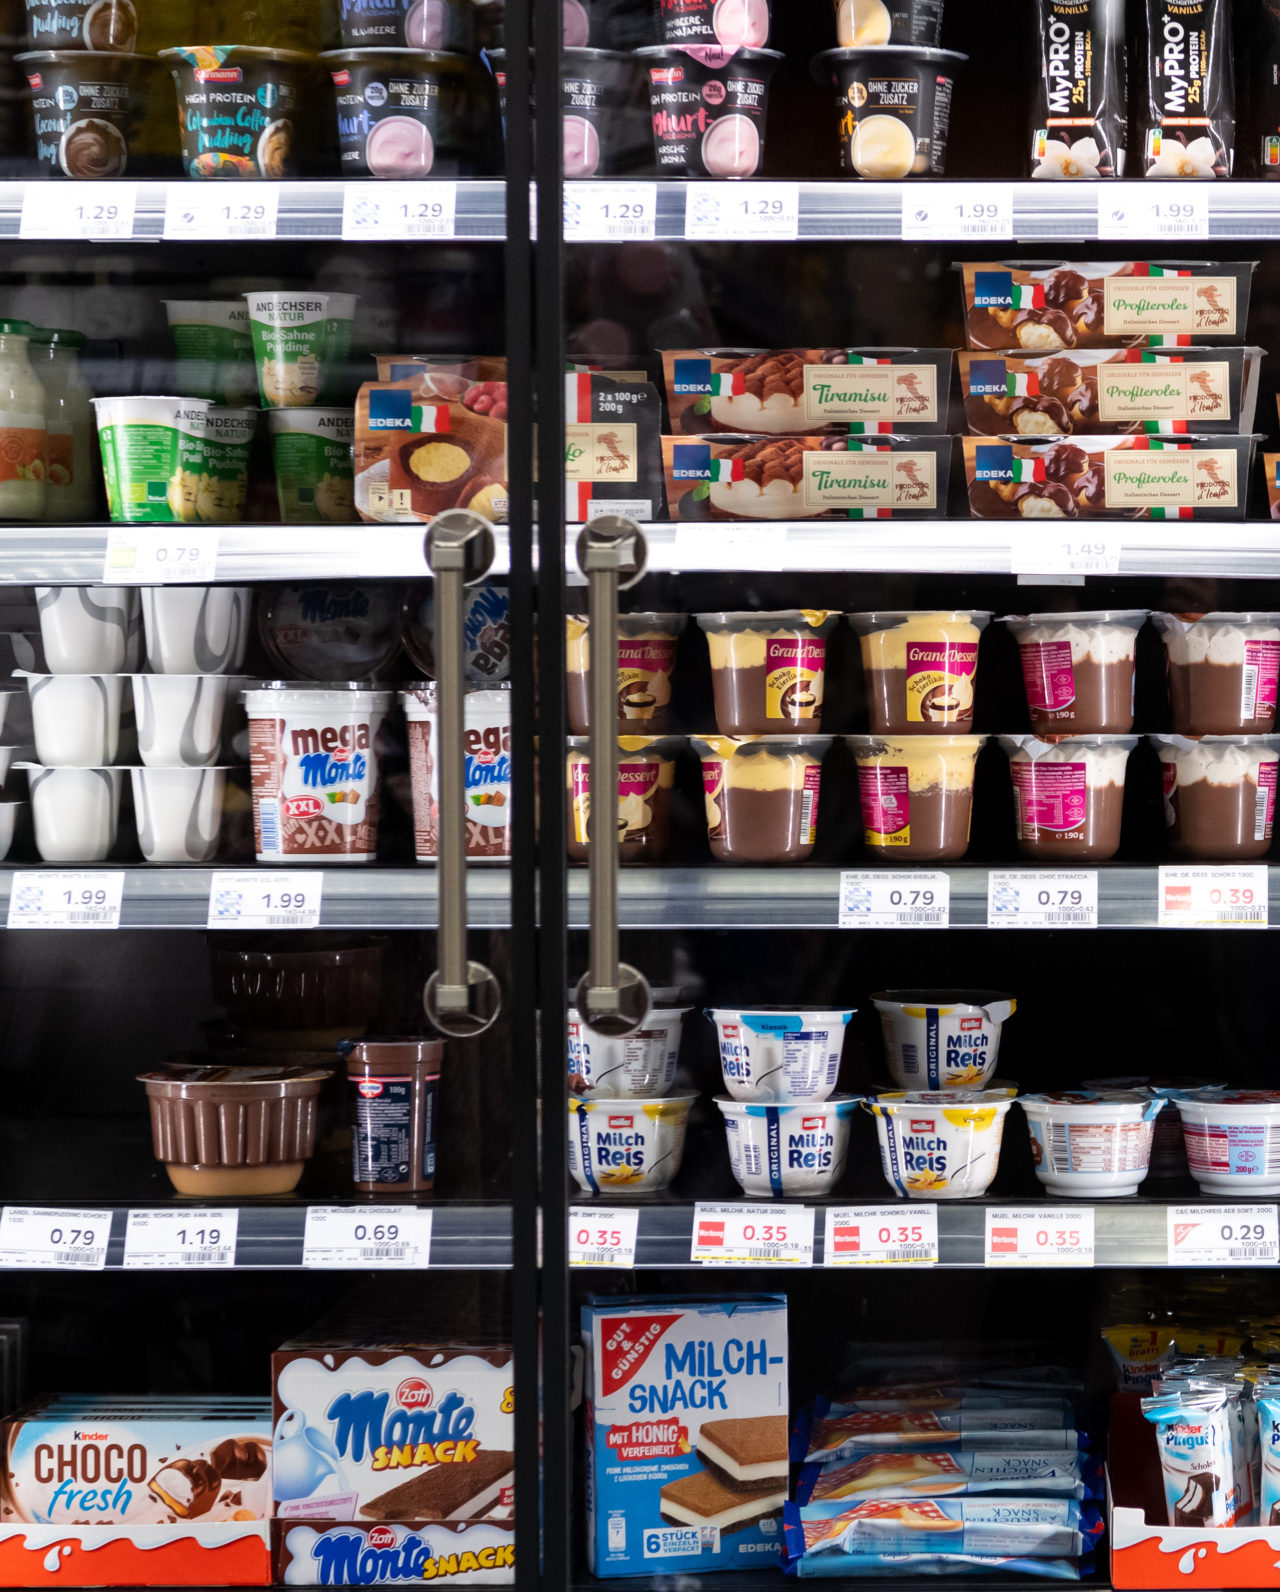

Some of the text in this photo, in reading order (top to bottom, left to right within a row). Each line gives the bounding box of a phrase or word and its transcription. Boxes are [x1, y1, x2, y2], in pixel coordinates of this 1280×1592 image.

[1053, 5, 1088, 15] VANILLE
[1072, 31, 1086, 104] 25g PROTEIN
[1188, 31, 1201, 104] 25g PROTEIN
[868, 82, 918, 93] OHNE ZUCKER
[186, 93, 256, 104] HIGH PROTEIN
[880, 94, 907, 104] ZUSATZ
[600, 203, 645, 218] 1.29
[739, 199, 784, 215] 1.29
[1150, 204, 1194, 218] 1.99
[256, 302, 322, 312] ANDECHSER
[975, 297, 1013, 305] EDEKA
[269, 313, 304, 321] NATUR
[267, 342, 310, 354] Pudding
[812, 384, 890, 404] Tiramisu
[970, 385, 1008, 393] EDEKA
[1106, 384, 1182, 403] Profiteroles
[369, 418, 412, 427] EDEKA
[812, 470, 889, 491] Tiramisu
[976, 470, 1014, 478] EDEKA
[1113, 471, 1189, 489] Profiteroles
[156, 548, 200, 562] 0.79
[291, 724, 370, 755] mega
[289, 801, 319, 815] XXL
[63, 890, 107, 906] 1.99
[261, 893, 306, 910] 1.99
[890, 891, 934, 905] 0.79
[1037, 891, 1082, 905] 0.79
[1210, 889, 1254, 904] 0.39
[947, 1034, 988, 1048] Milch
[929, 1023, 937, 1077] ORIGINAL
[946, 1049, 986, 1068] Reis
[597, 1132, 645, 1146] Milch
[903, 1137, 947, 1151] Milch
[597, 1147, 644, 1166] Reis
[789, 1149, 831, 1168] Reis
[50, 1228, 94, 1245] 0.79
[177, 1229, 220, 1245] 1.19
[354, 1225, 399, 1241] 0.69
[576, 1230, 621, 1246] 0.35
[878, 1227, 922, 1243] 0.35
[1036, 1230, 1080, 1246] 0.35
[1220, 1224, 1265, 1241] 0.29
[606, 1322, 632, 1351] GUT
[611, 1323, 661, 1380] GÜNSTIG
[621, 1341, 633, 1352] &
[328, 1390, 476, 1463] Monte
[35, 1444, 147, 1483] CHOCO
[372, 1440, 481, 1471] SNACK
[48, 1477, 132, 1518] fresh
[992, 1508, 1040, 1517] SNACK
[646, 1534, 660, 1553] 6
[662, 1530, 698, 1541] STÜCK
